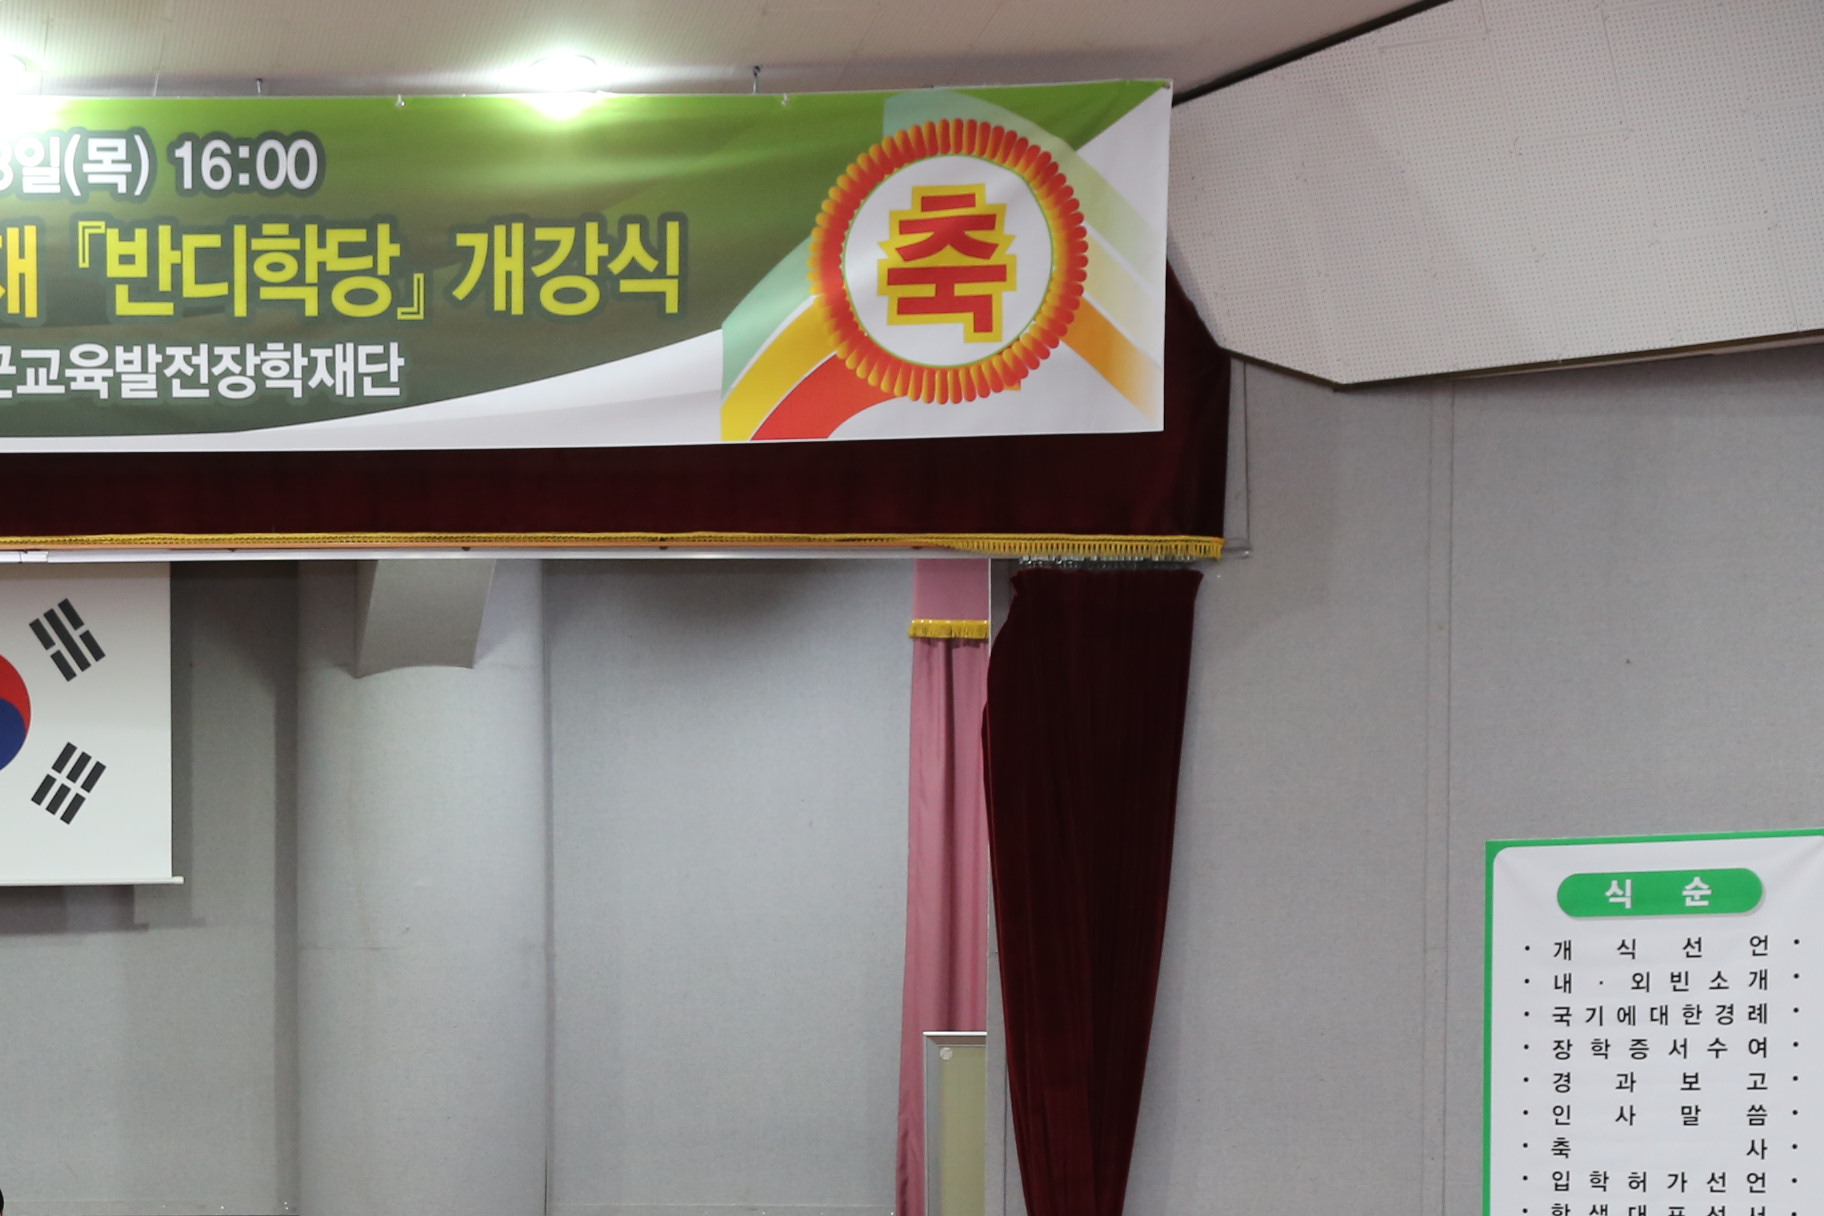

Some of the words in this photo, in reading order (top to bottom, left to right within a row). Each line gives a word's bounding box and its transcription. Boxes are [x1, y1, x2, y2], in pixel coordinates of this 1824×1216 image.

[176, 138, 318, 190] 16:00
[454, 220, 681, 316] 개강식
[880, 186, 1017, 342] 축
